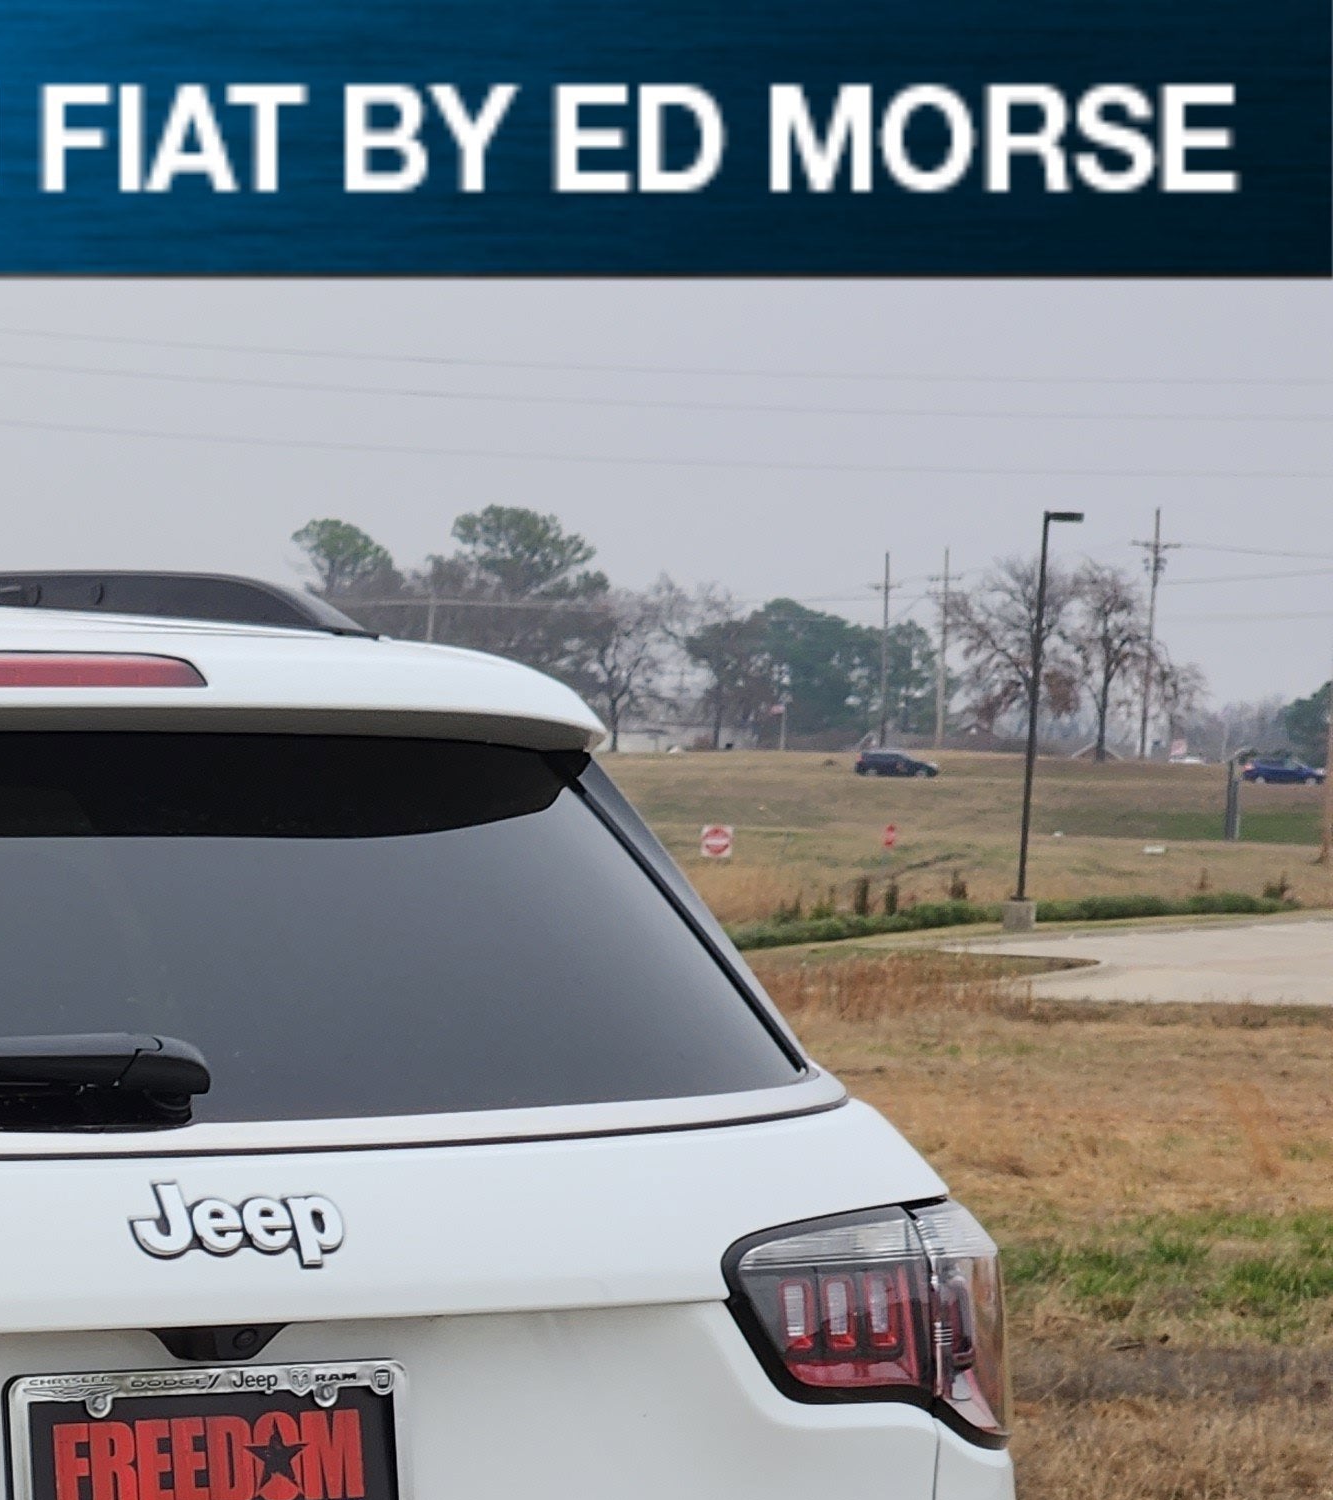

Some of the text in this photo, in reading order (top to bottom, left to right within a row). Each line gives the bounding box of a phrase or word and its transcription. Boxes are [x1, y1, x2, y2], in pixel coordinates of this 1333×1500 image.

[128, 1179, 344, 1269] Jeep
[232, 1370, 278, 1391] Jeep
[314, 1372, 357, 1383] RAM
